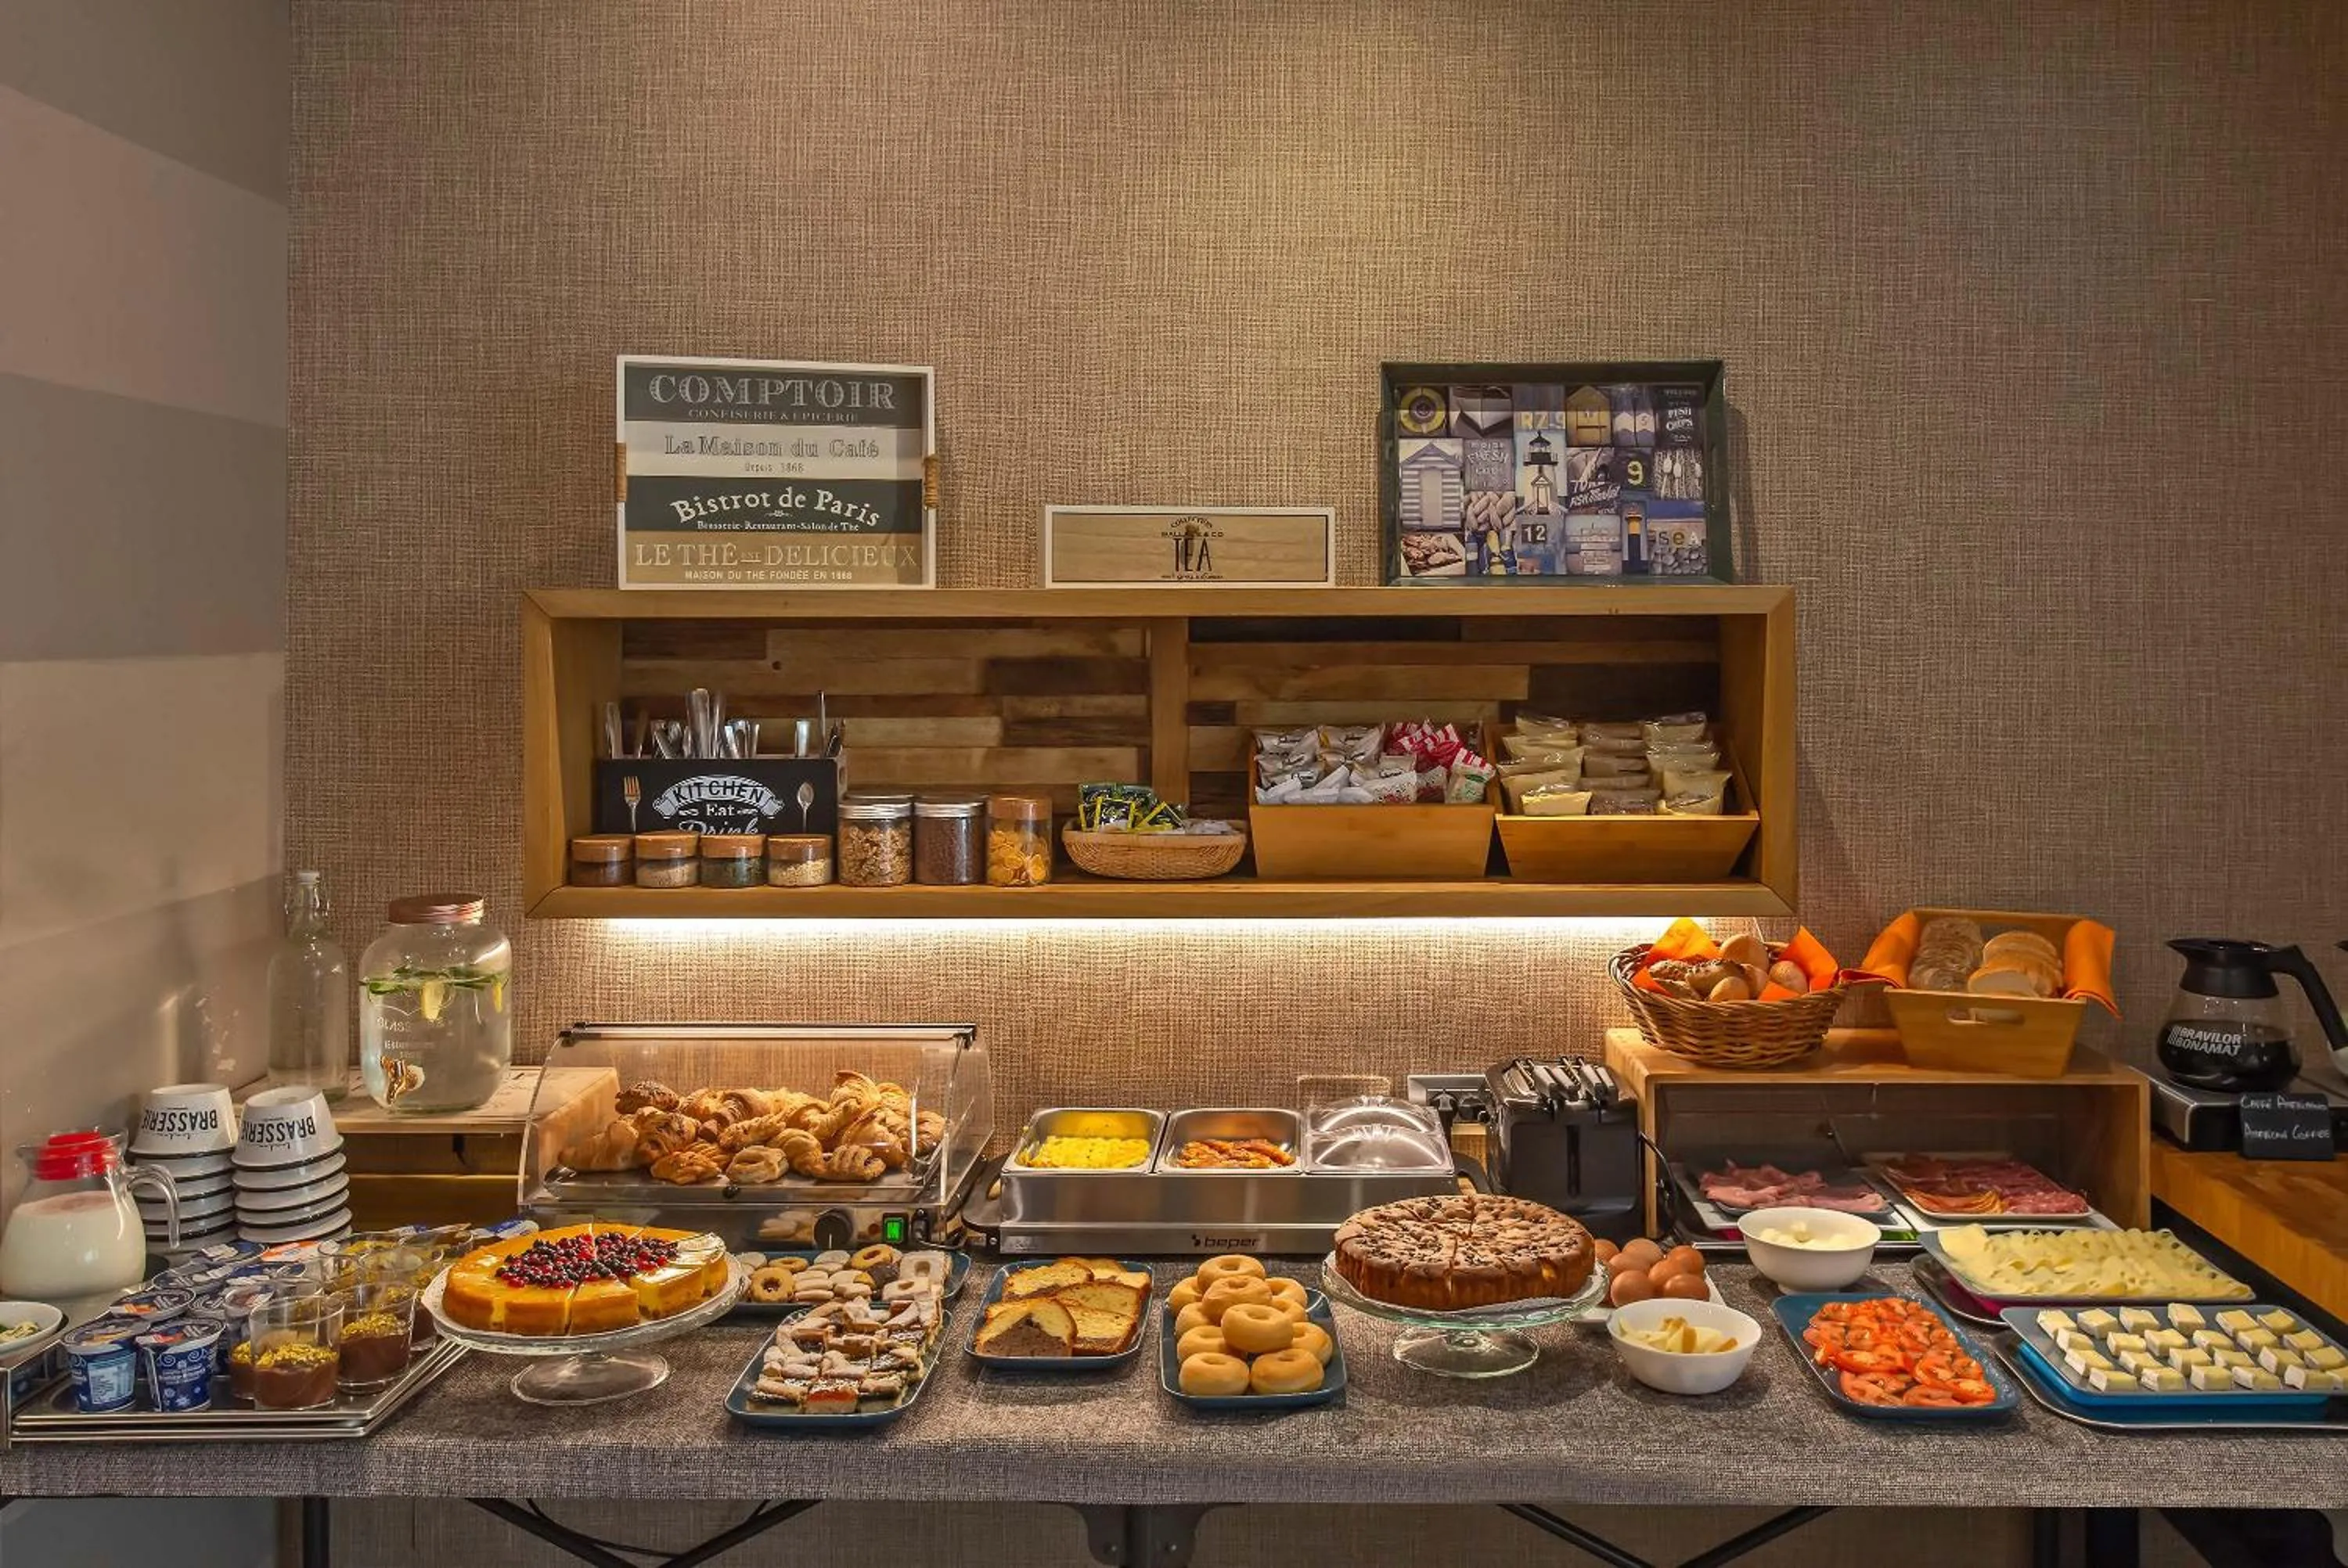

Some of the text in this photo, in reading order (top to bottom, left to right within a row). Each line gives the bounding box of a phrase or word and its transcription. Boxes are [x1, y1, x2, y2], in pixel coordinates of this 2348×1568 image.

[648, 375, 895, 410] COMPTOIR
[664, 435, 880, 458] La Maison du Café
[1627, 460, 1644, 486] 9
[670, 486, 880, 527] Bistrot de Paris
[1524, 525, 1546, 542] 12
[635, 544, 671, 566] LE
[764, 545, 917, 567] DELICIEUX
[1173, 538, 1212, 571] TEA
[685, 570, 723, 580] MAISON
[728, 570, 742, 580] DU
[813, 570, 827, 580] EN
[673, 780, 764, 804] KITCHEN
[707, 804, 735, 816] Eat
[2176, 1037, 2242, 1057] BONAMAT
[2179, 1027, 2242, 1045] BRAVILOR
[1205, 1235, 1259, 1250] beper
